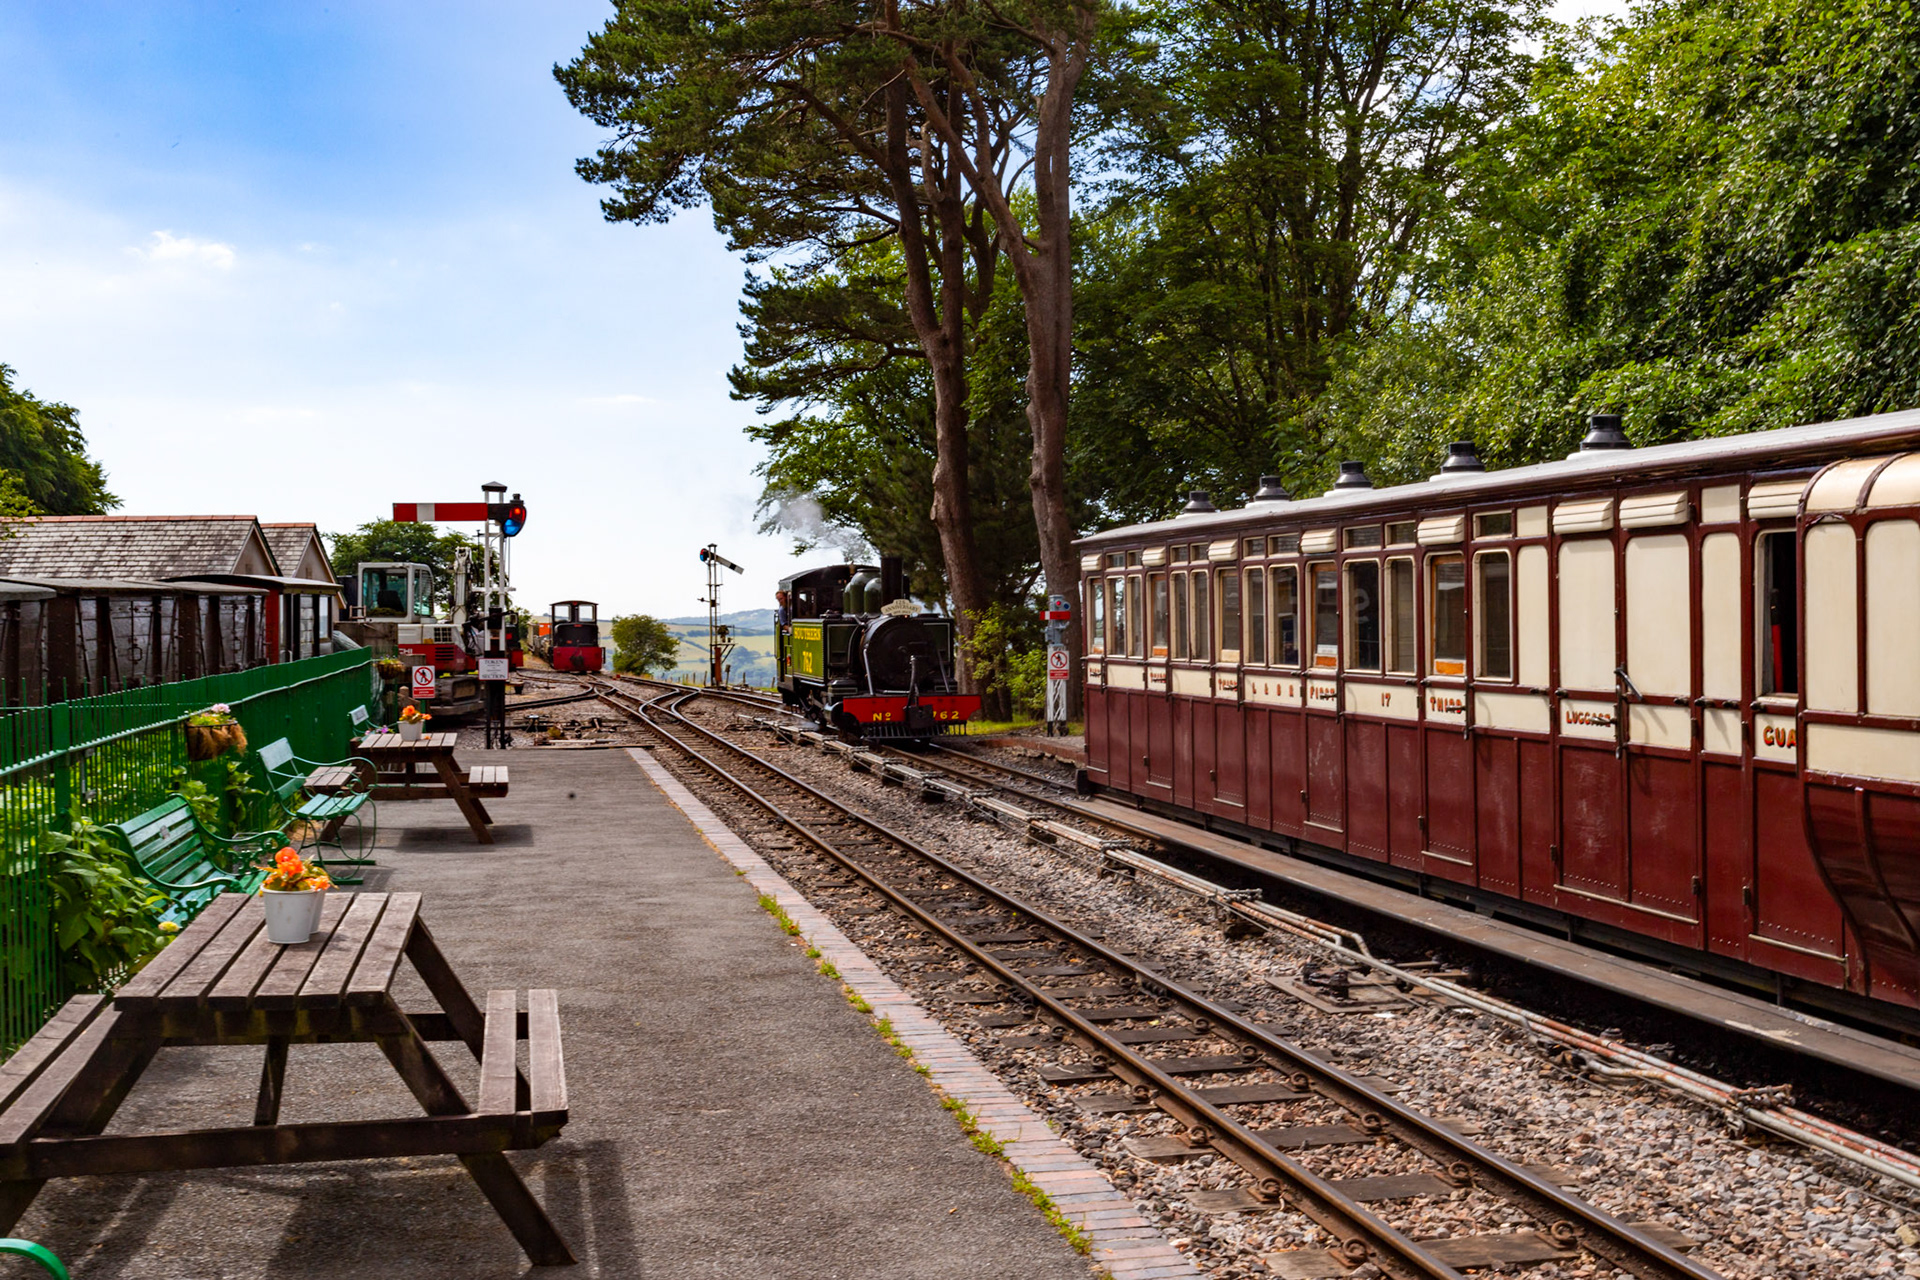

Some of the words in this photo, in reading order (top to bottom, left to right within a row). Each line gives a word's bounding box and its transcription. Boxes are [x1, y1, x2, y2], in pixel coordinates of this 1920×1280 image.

[794, 627, 821, 640] SOUTHERN
[802, 650, 813, 674] 762
[1310, 685, 1335, 701] FIRST
[1381, 692, 1391, 707] 17
[1430, 696, 1462, 714] THIRD
